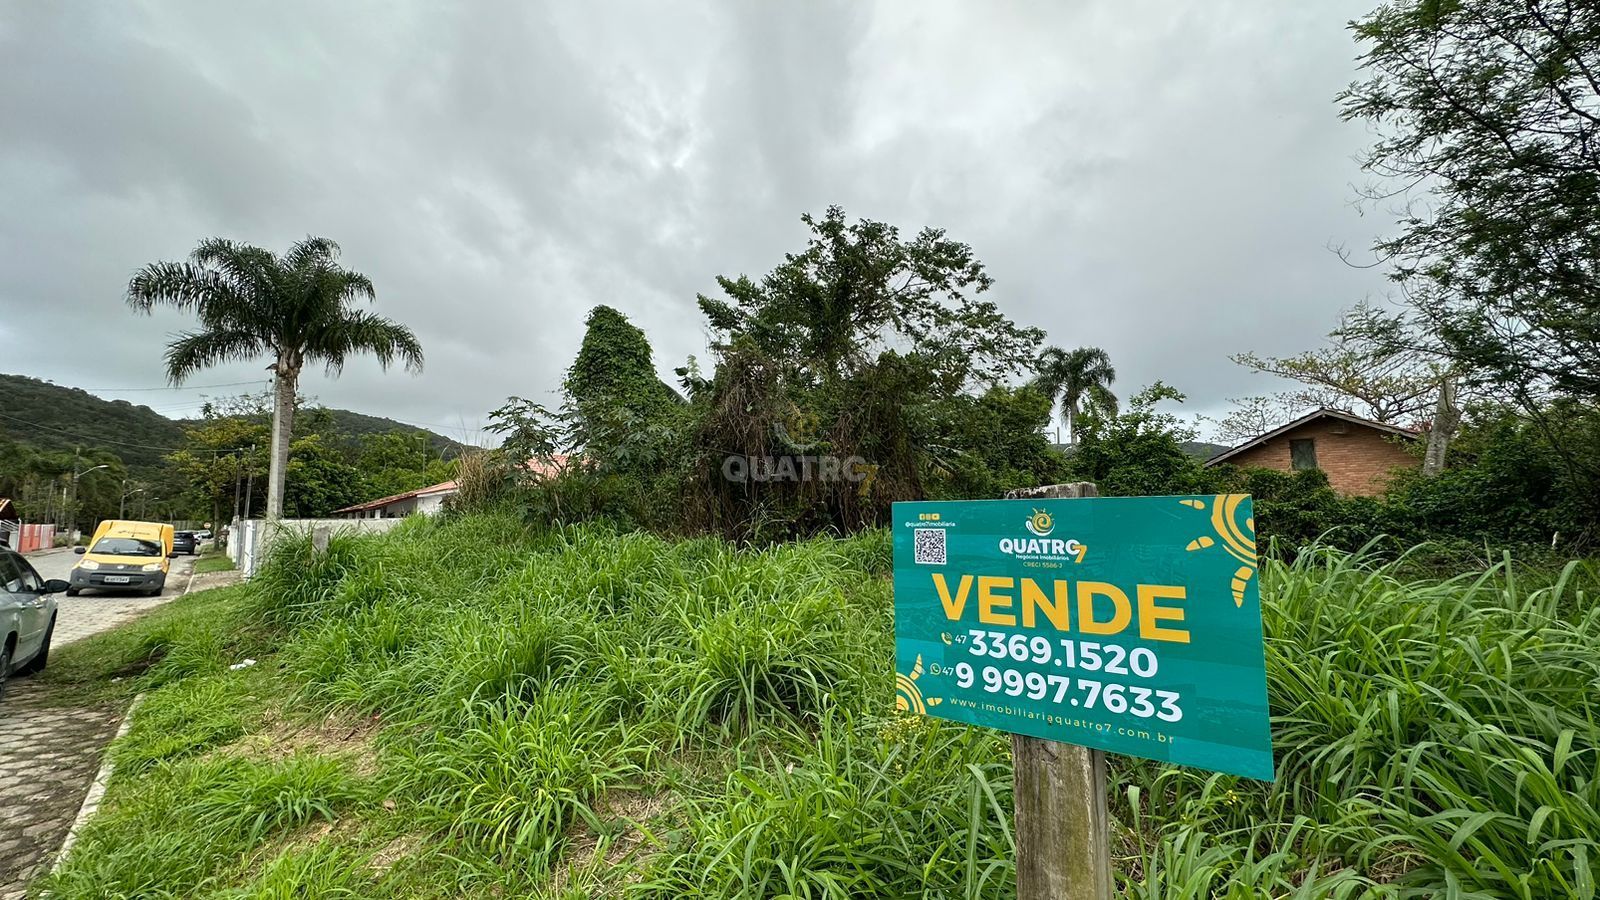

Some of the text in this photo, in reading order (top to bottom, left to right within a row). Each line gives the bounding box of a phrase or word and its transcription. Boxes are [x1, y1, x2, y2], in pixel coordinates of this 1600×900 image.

[1016, 553, 1039, 561] Negócios
[931, 573, 1190, 643] VENDE
[955, 629, 1158, 678] 47 3369.1520
[942, 662, 1183, 722] 47 9 9997.7633
[950, 697, 1174, 744] www.imobiliariaquatro7.com.br
